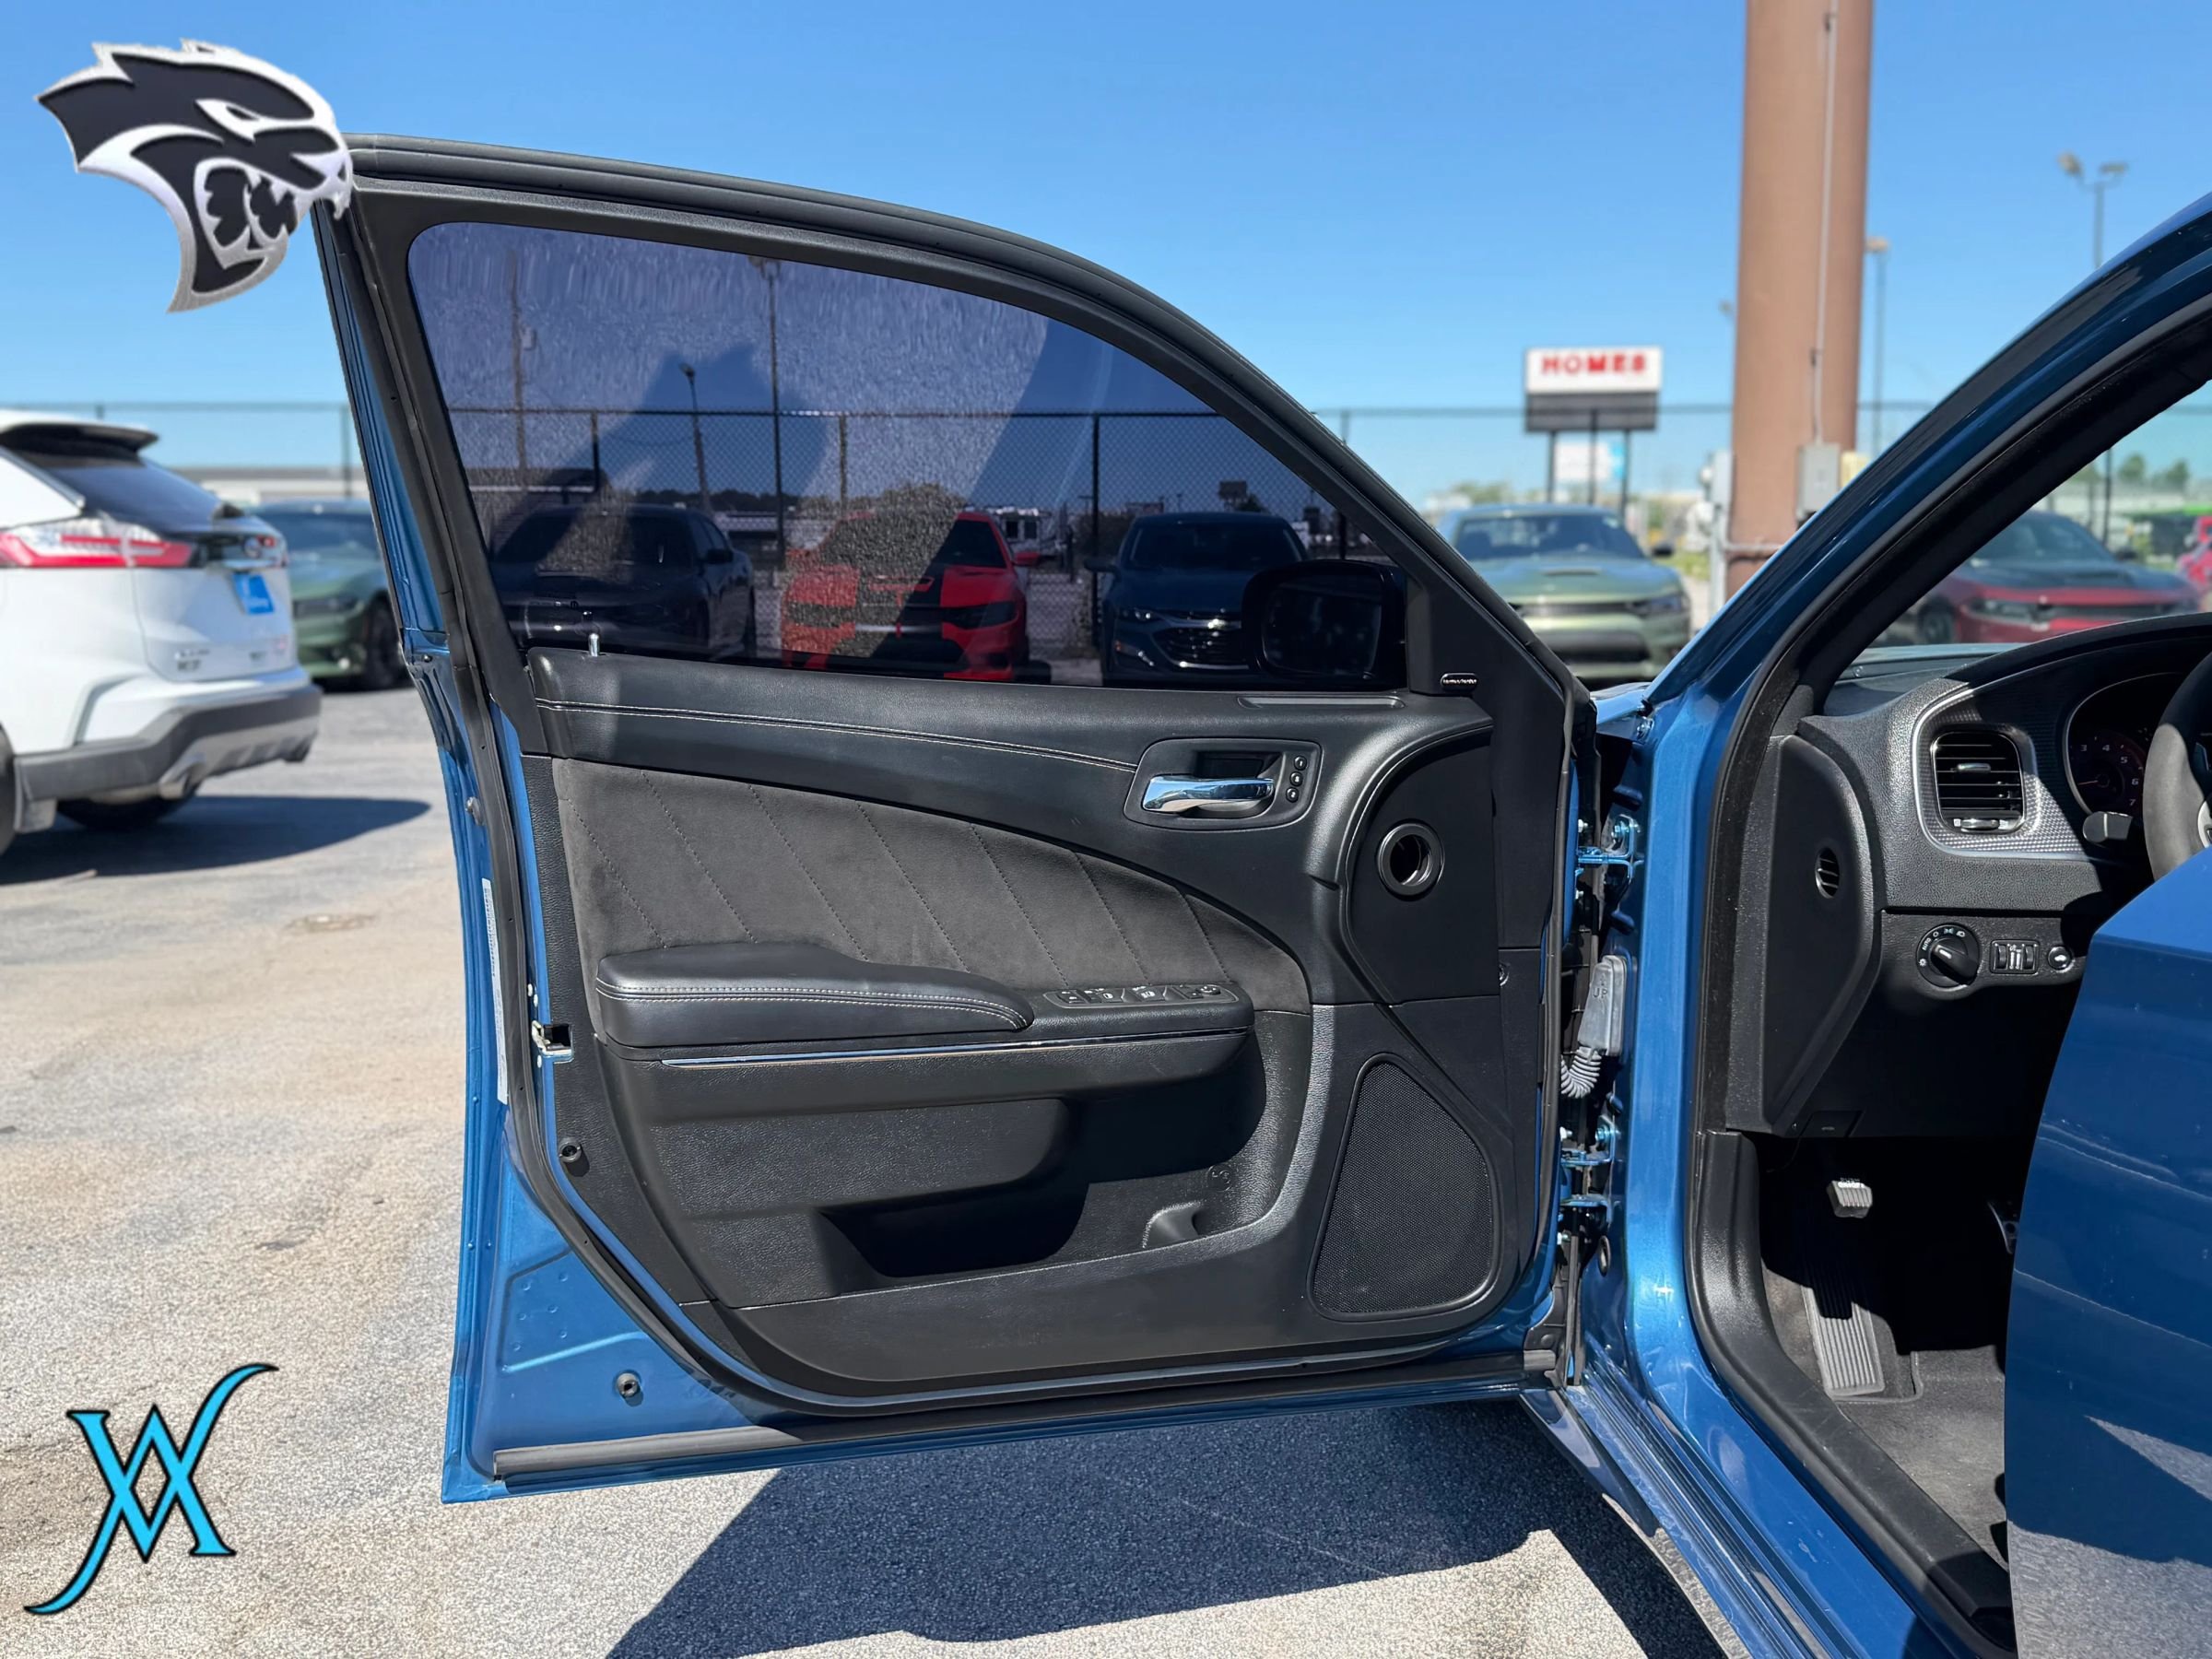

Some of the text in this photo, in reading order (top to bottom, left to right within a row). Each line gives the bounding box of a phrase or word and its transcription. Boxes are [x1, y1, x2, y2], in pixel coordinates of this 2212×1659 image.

[1541, 354, 1646, 374] HOMES
[2079, 744, 2088, 752] 3
[2101, 744, 2111, 752] 4
[2120, 756, 2128, 764] 5
[2128, 798, 2136, 806] 7
[1593, 987, 1608, 999] UP
